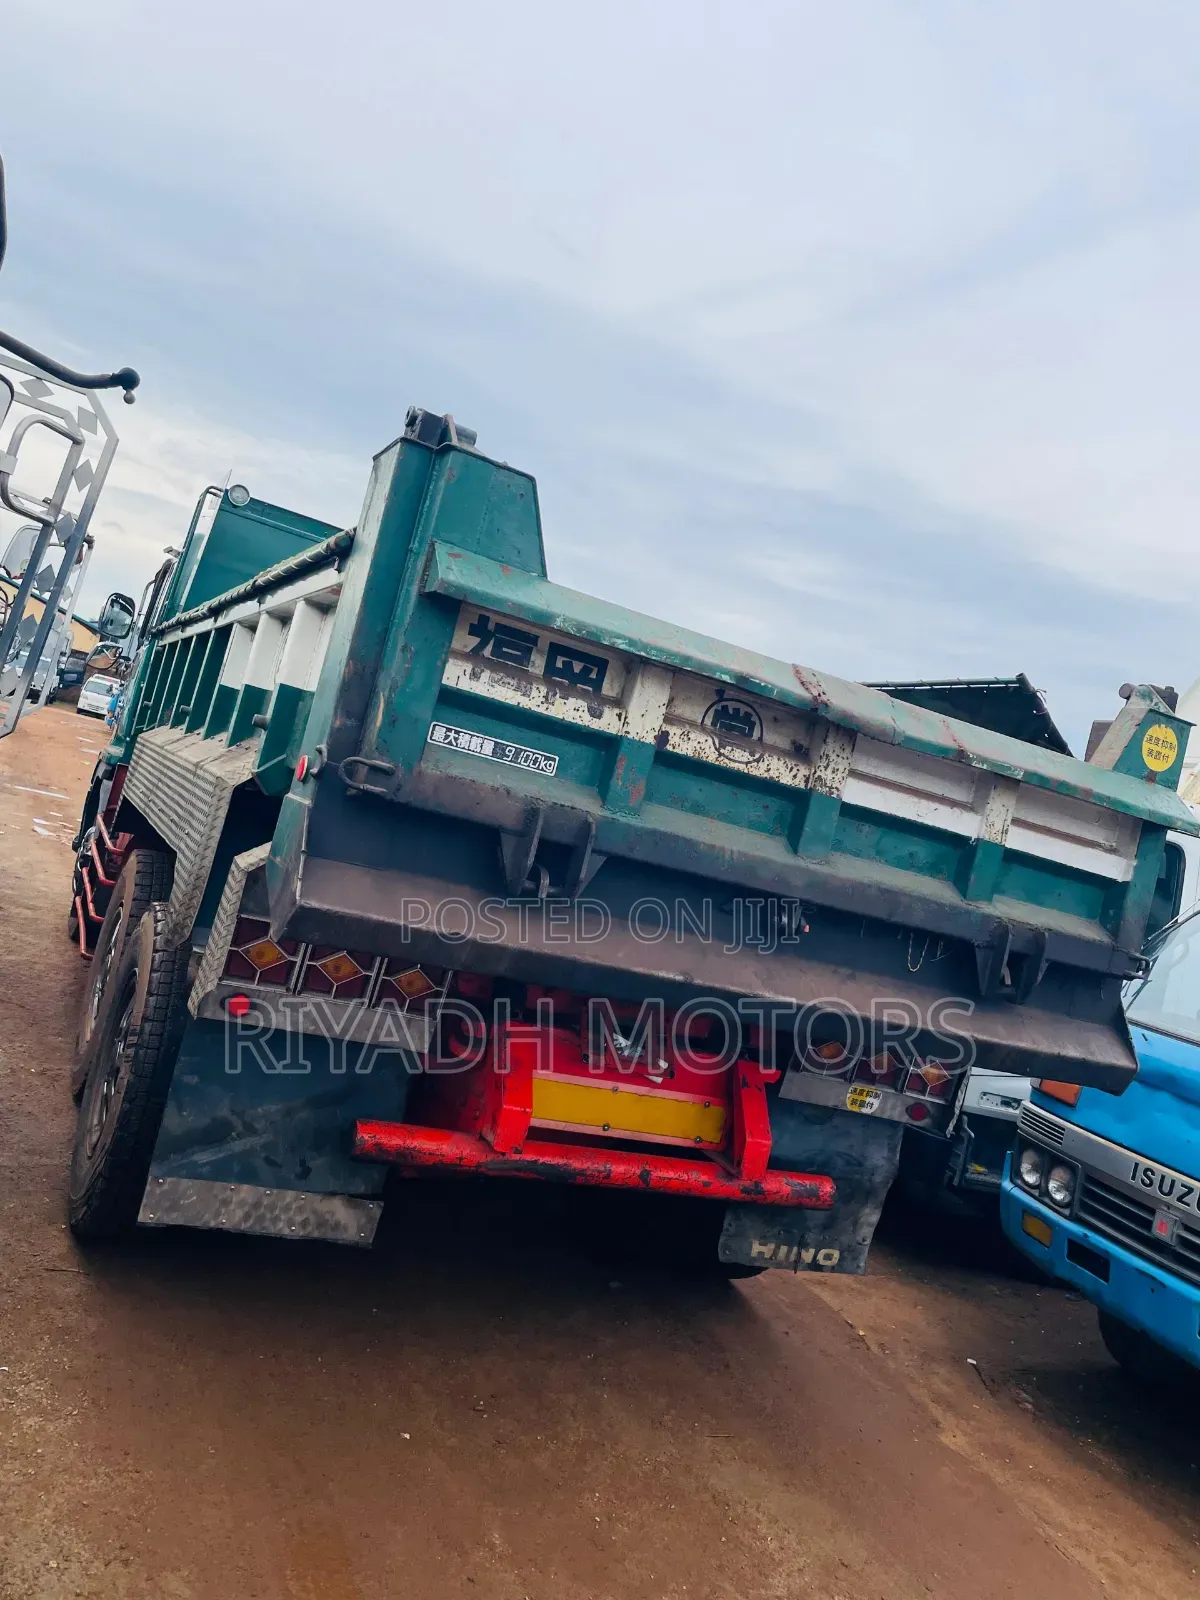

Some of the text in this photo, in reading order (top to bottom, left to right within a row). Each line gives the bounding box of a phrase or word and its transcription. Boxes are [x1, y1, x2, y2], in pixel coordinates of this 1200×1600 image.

[431, 725, 495, 757] 最大積載量
[1145, 734, 1177, 752] 速度抑制
[1147, 747, 1170, 764] 装置付
[1130, 1161, 1200, 1214] ISUZ
[750, 1239, 841, 1266] HINO
